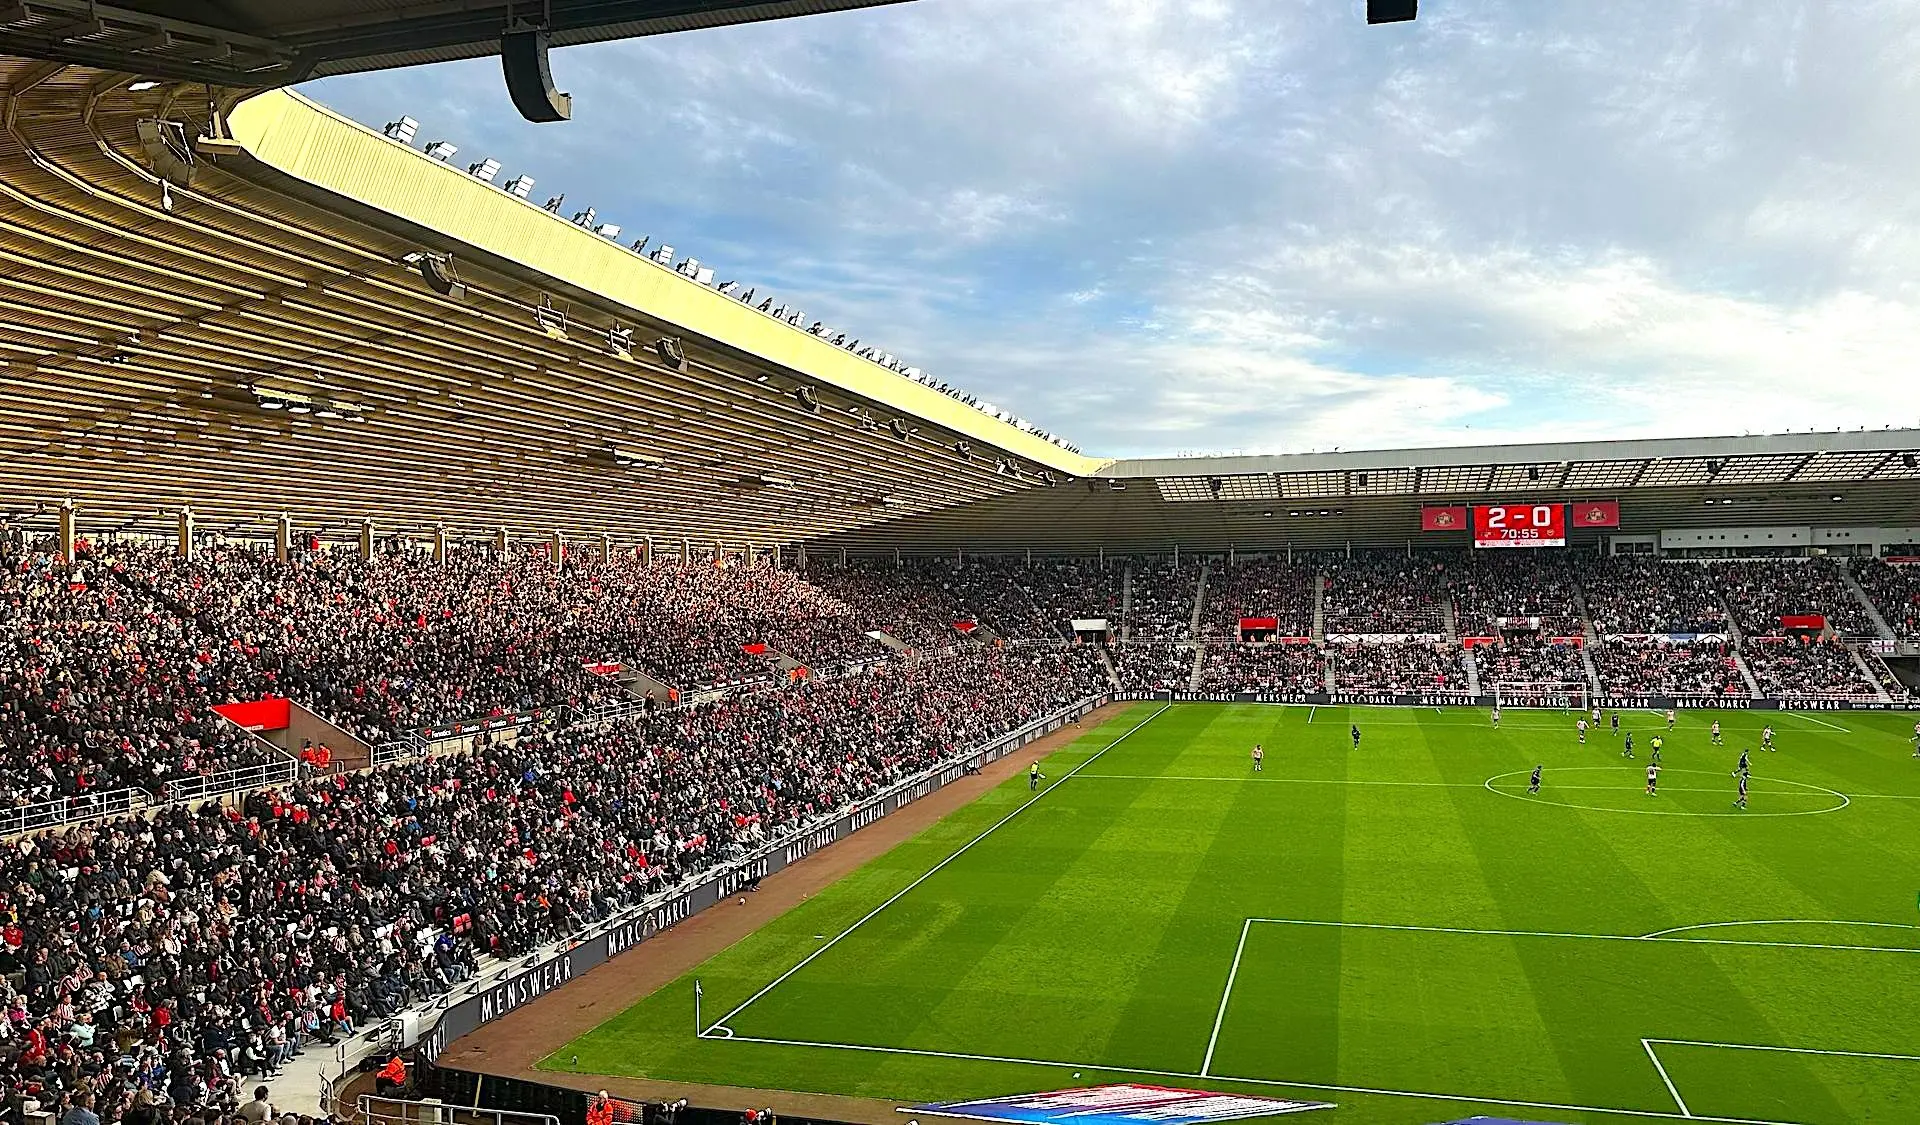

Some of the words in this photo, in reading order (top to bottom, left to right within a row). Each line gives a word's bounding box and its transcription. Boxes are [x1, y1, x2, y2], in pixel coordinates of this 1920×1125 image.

[1488, 507, 1506, 528] 2
[1532, 506, 1551, 527] 0
[1500, 528, 1539, 539] 70:55
[1114, 691, 1155, 701] MENSWEAR
[1174, 692, 1198, 701] MARC
[1209, 692, 1236, 702] DARCY
[1330, 694, 1355, 704] MARC
[1369, 695, 1397, 704] DARCY
[1422, 696, 1476, 706] MENSWEAR
[1499, 697, 1525, 706] MARC
[1540, 697, 1569, 707] DARC
[1592, 698, 1649, 708] MENSWEAR
[1676, 699, 1704, 708] MARC
[1719, 699, 1751, 709] DARCY
[786, 839, 807, 865] MARC
[816, 824, 837, 849] DARCY
[607, 920, 641, 957] MARC
[658, 895, 691, 930] DARCY
[481, 955, 572, 1023] MENSWEAR
